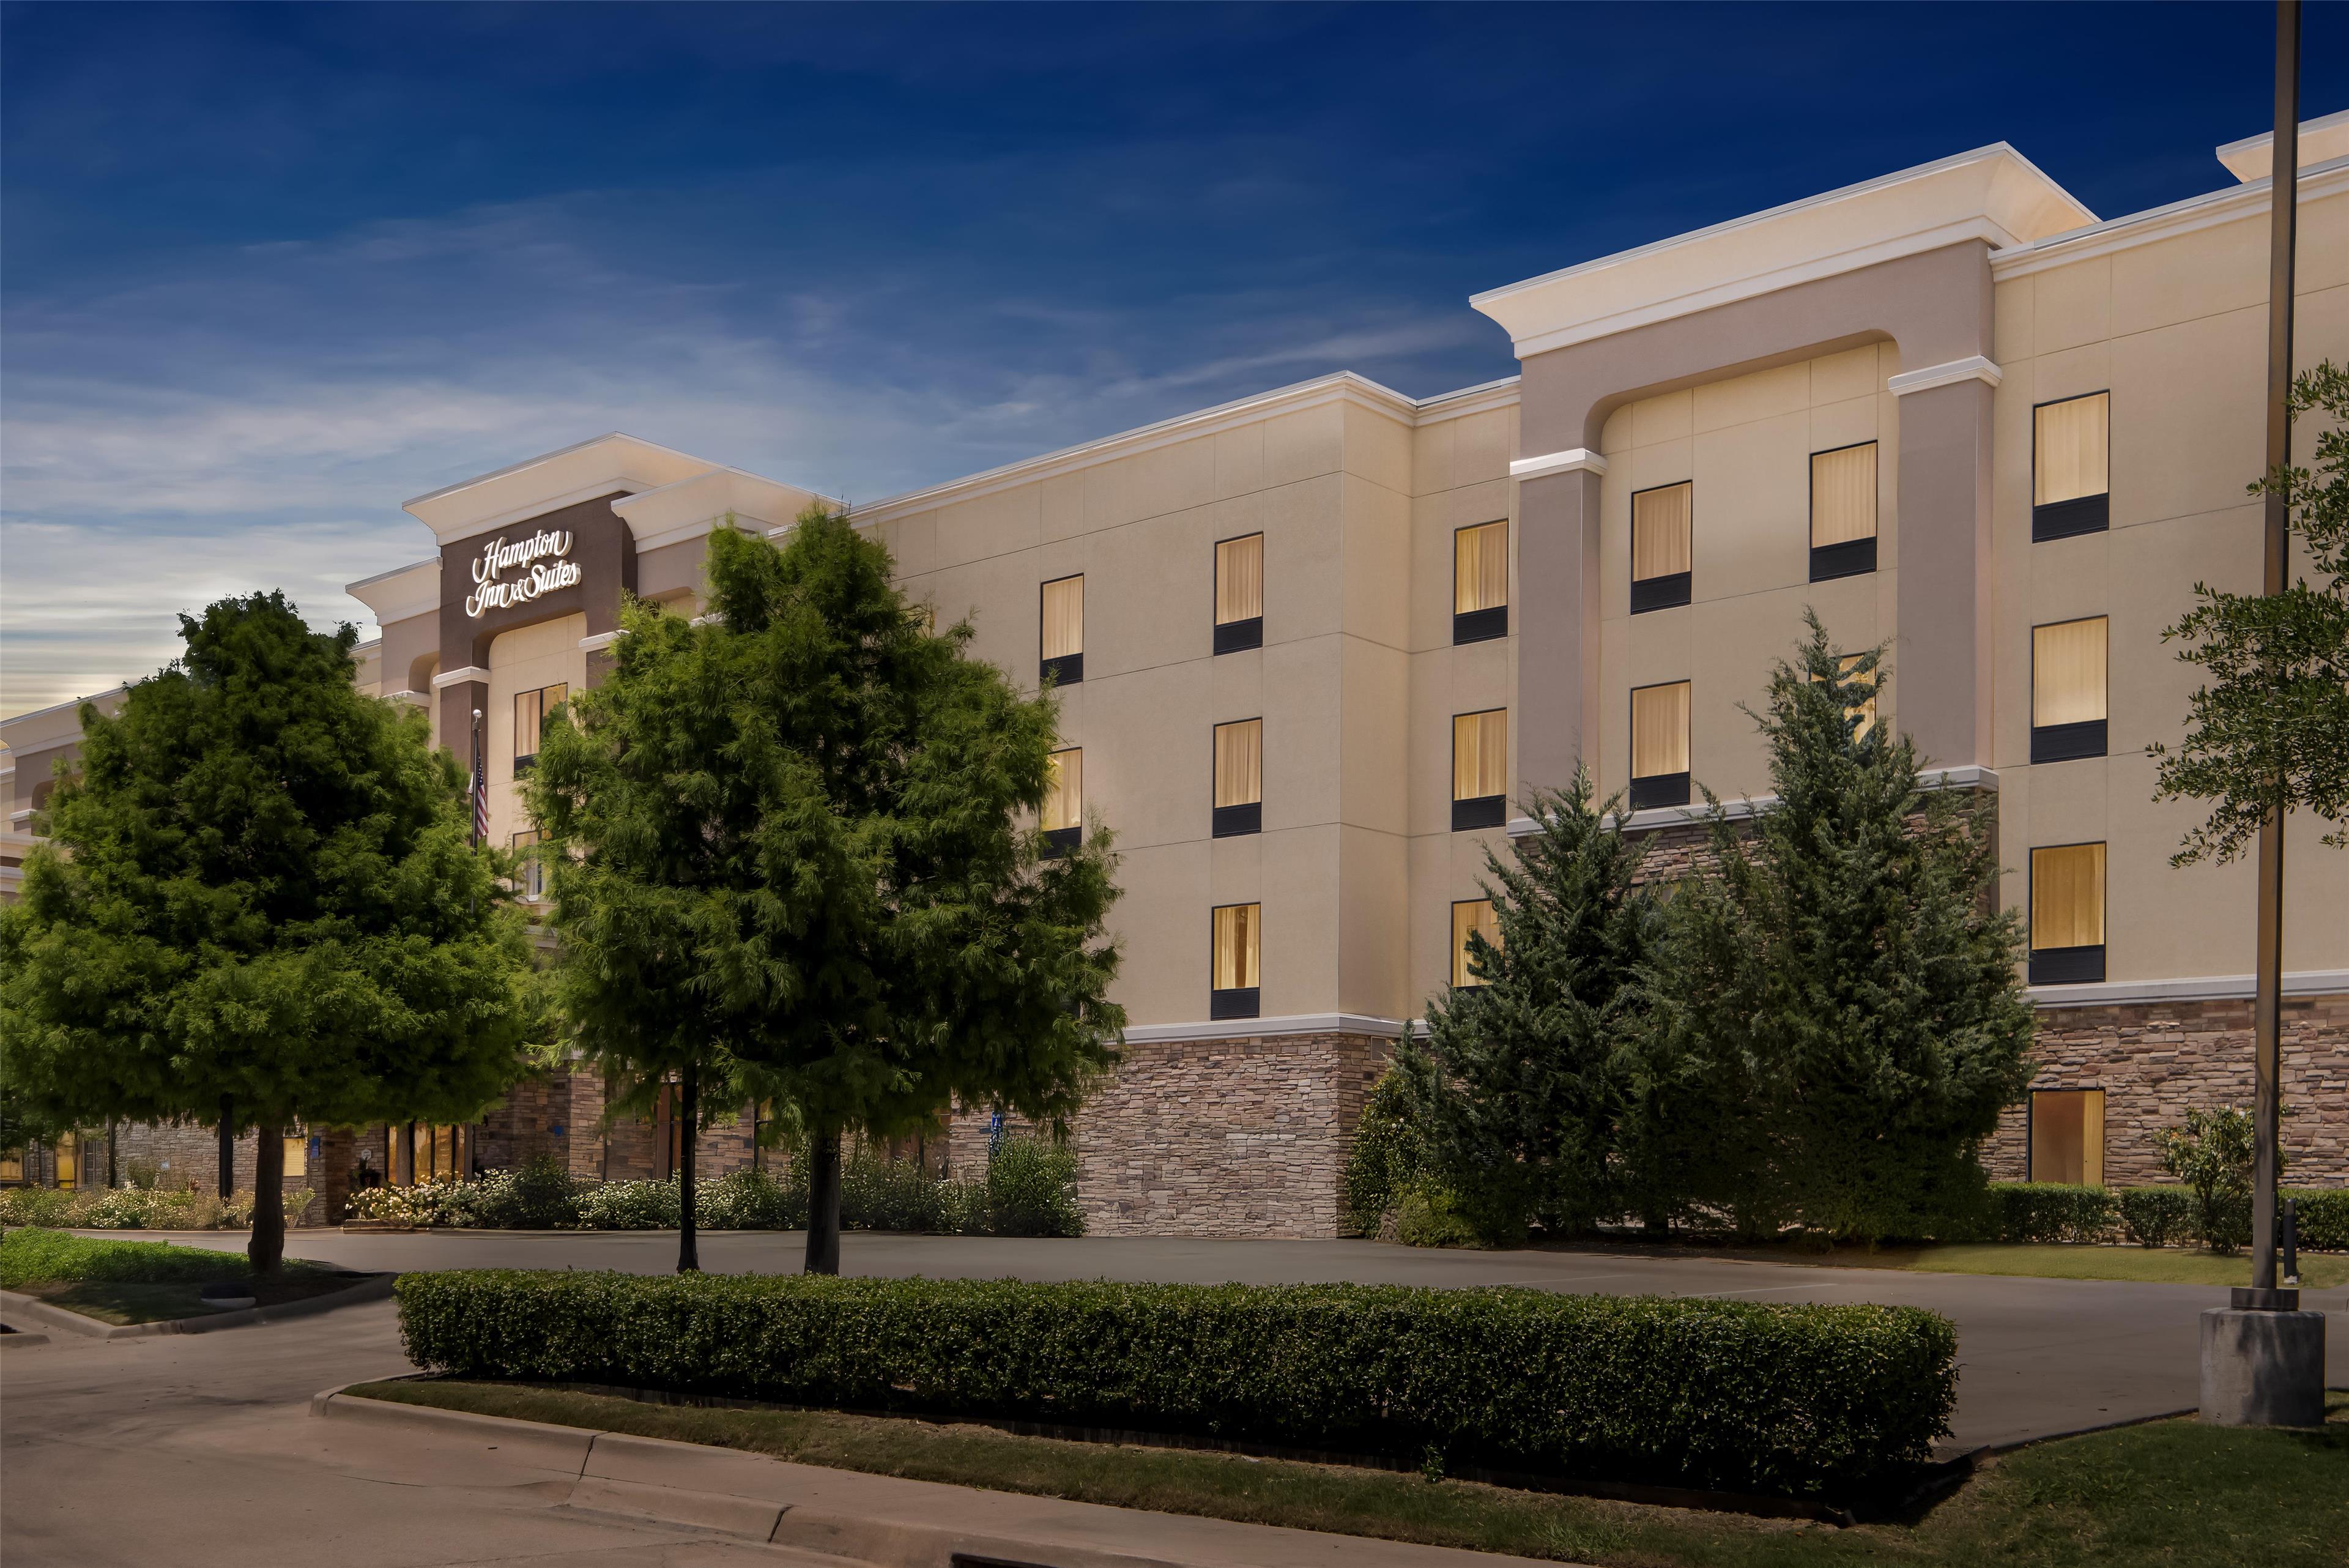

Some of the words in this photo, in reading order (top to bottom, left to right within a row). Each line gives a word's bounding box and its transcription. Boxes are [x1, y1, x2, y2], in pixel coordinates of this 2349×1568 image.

[472, 529, 573, 583] Hampton
[466, 580, 514, 619] Inn
[513, 578, 530, 602] &
[524, 559, 581, 598] Suites
